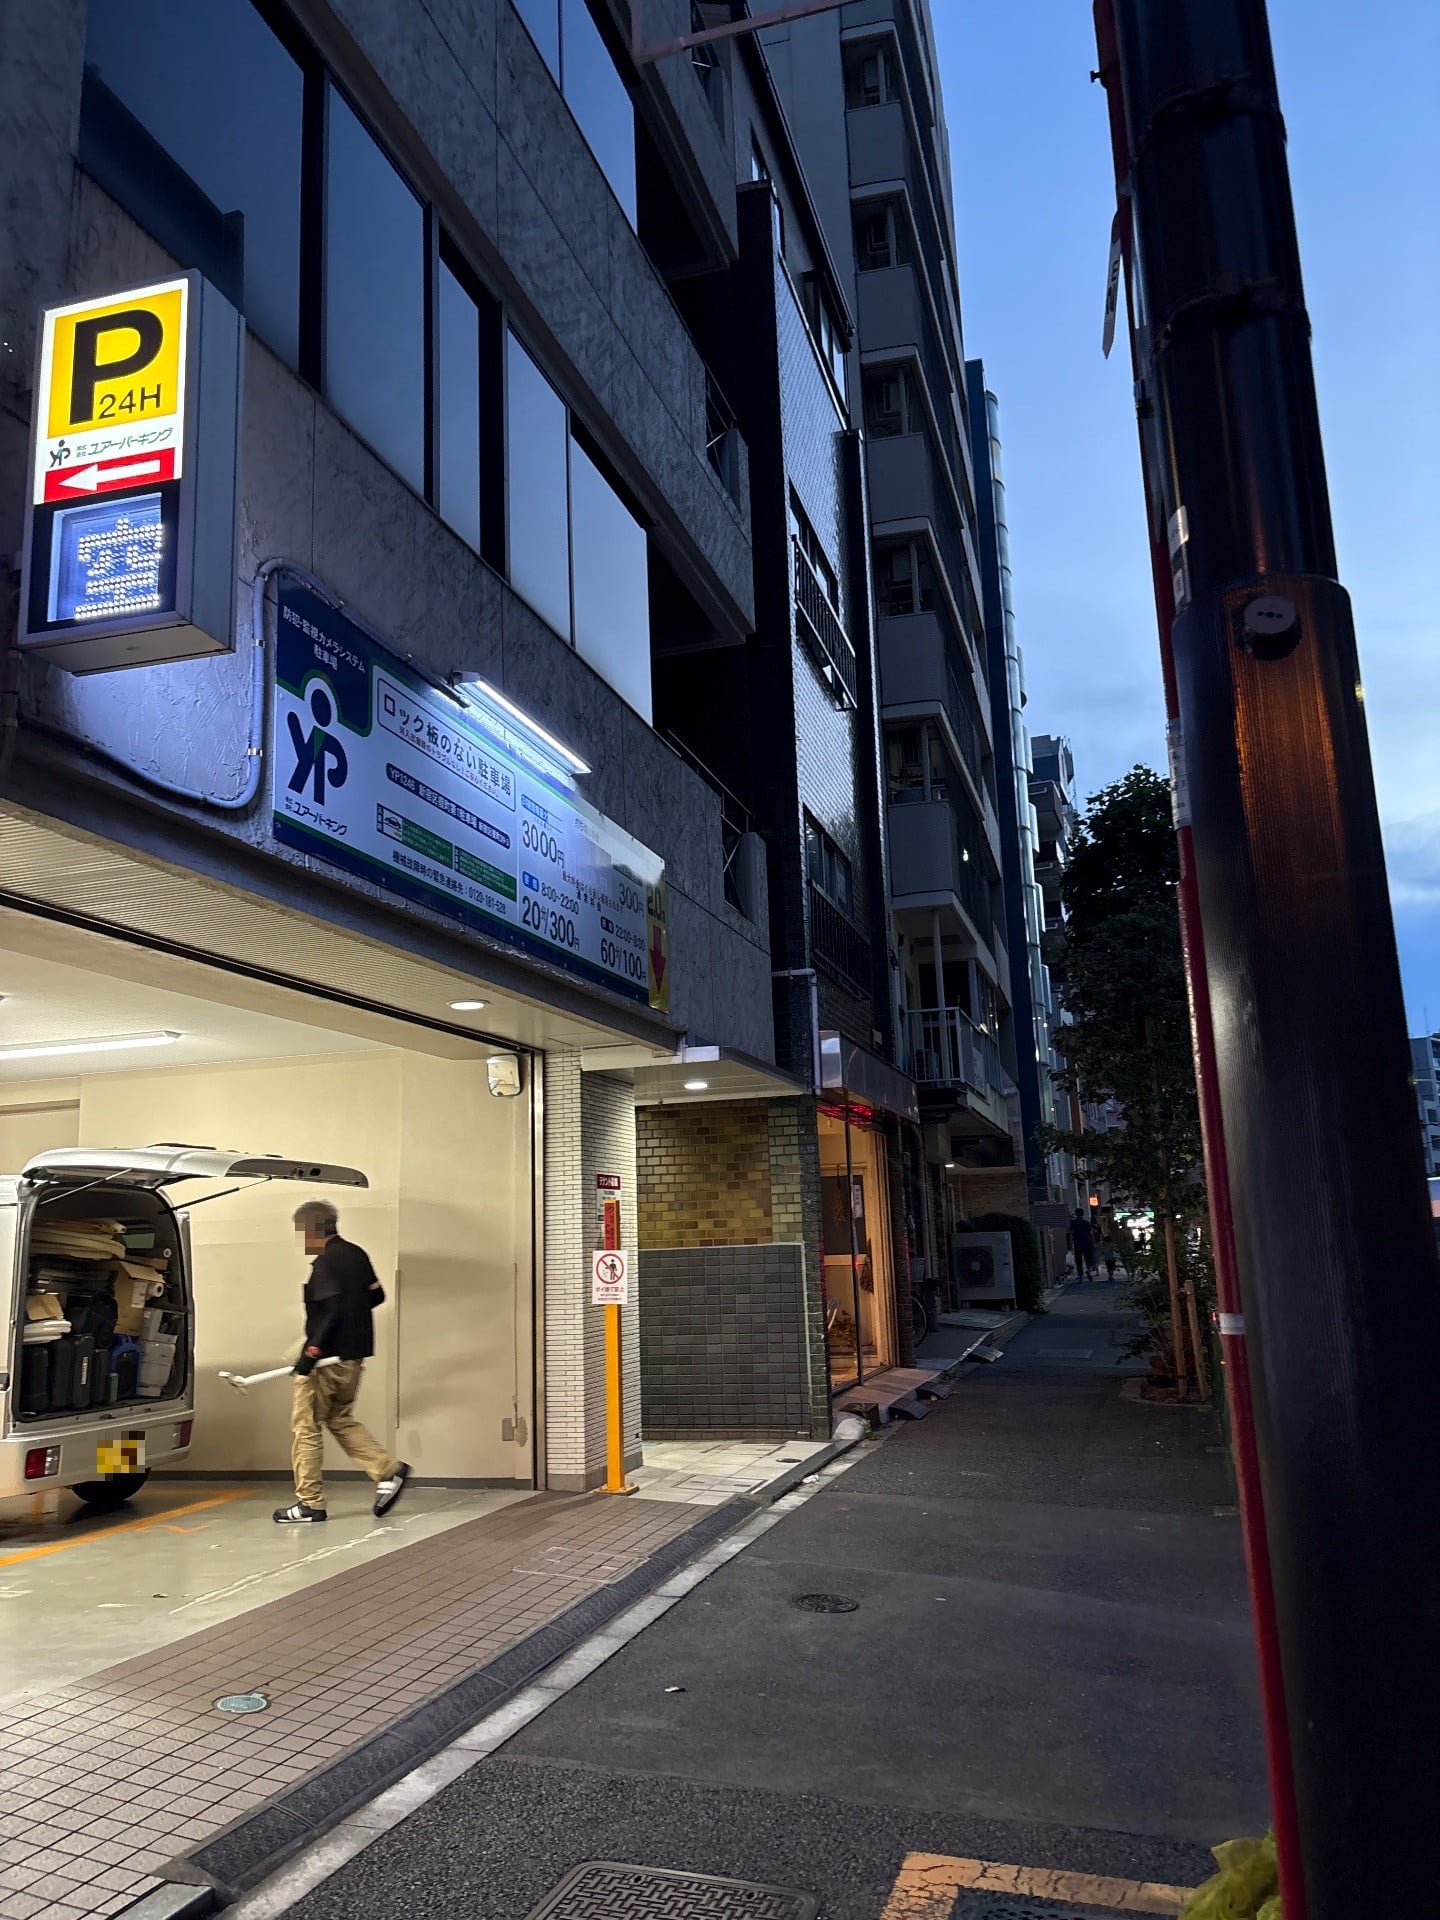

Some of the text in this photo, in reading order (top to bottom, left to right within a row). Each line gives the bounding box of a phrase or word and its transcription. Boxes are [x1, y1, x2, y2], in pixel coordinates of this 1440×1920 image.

[70, 309, 164, 425] P
[98, 383, 161, 420] 24H
[87, 428, 173, 456] ユアーパーキング
[75, 516, 163, 620] 空
[314, 644, 338, 671] 駐車場
[384, 693, 511, 796] ロック板のない駐車場
[292, 801, 348, 835] ユアーパーキング
[522, 819, 565, 869] 3000円
